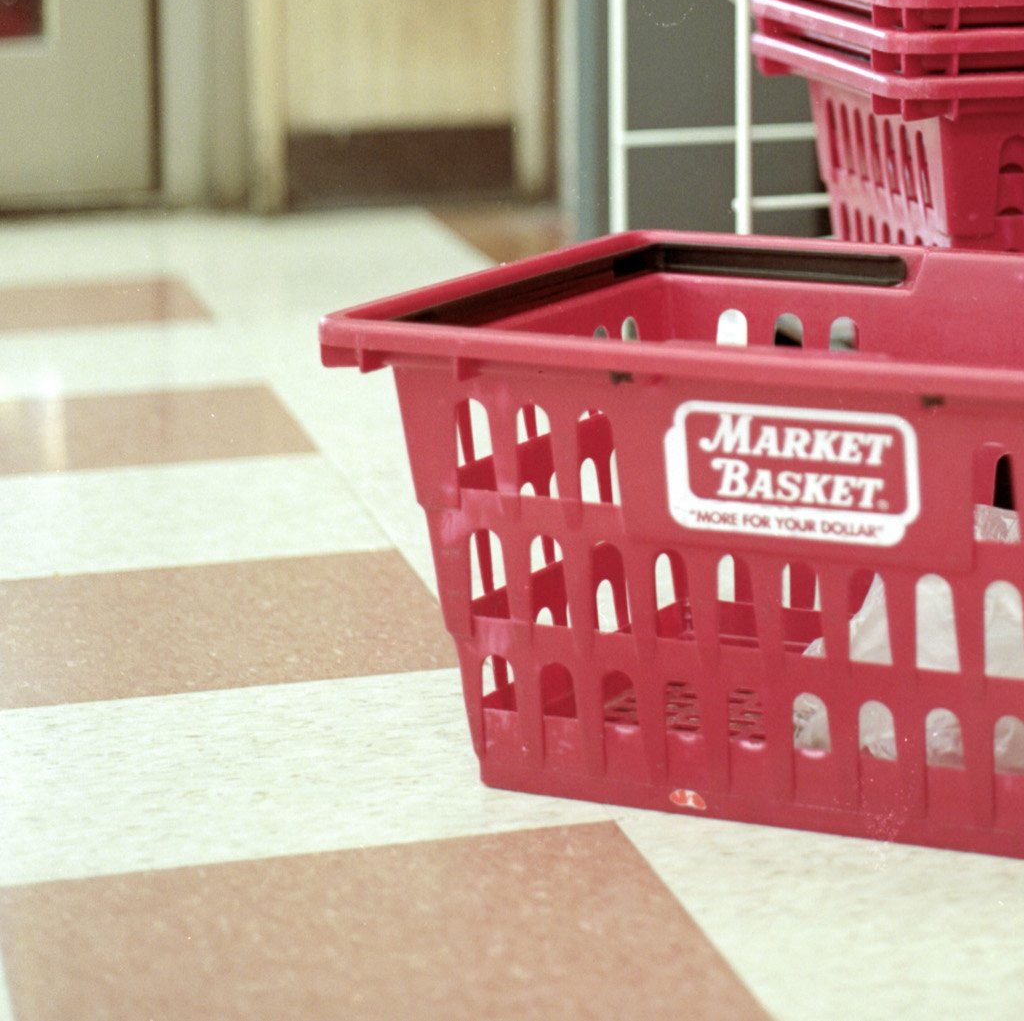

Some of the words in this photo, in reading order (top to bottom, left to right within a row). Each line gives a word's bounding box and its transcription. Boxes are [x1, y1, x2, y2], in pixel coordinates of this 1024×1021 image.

[699, 413, 893, 466] MARKET
[689, 510, 738, 526] "MORE
[743, 514, 771, 529] FOR
[776, 516, 815, 532] YOUR
[820, 519, 884, 538] DOLLAR"
